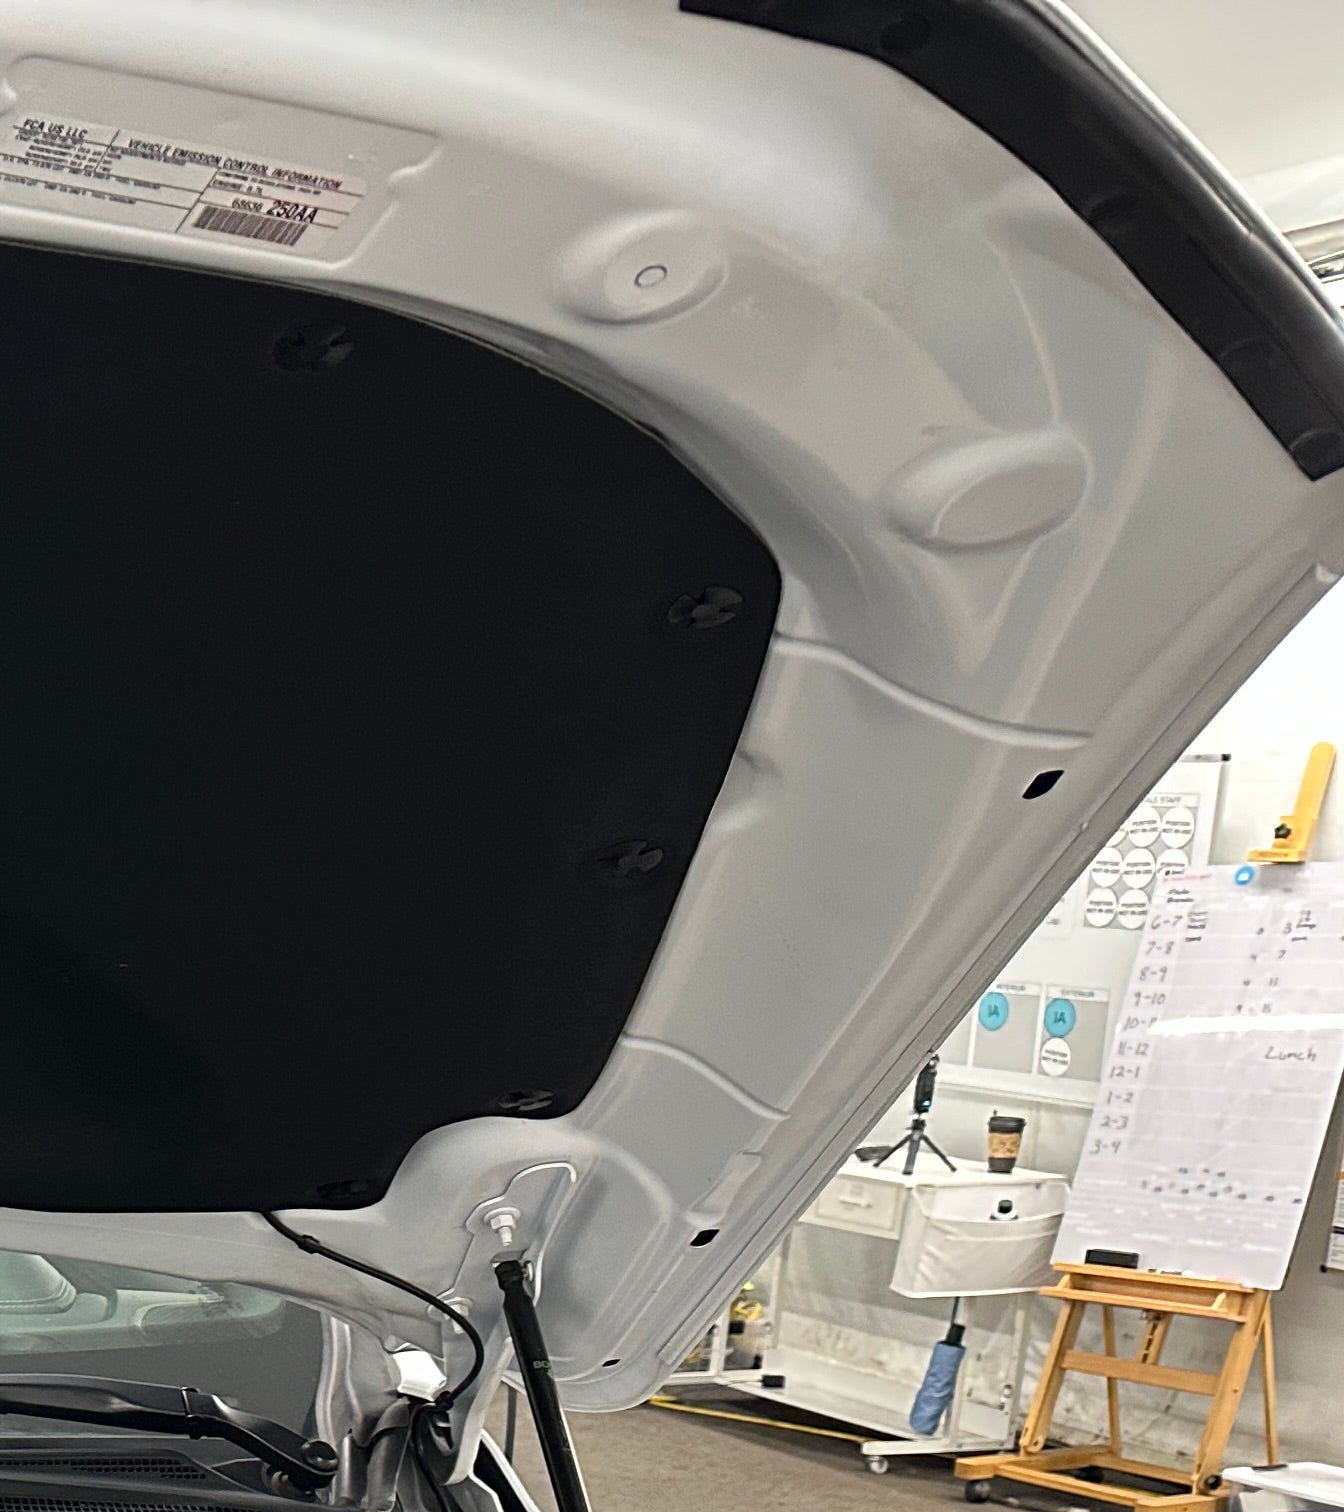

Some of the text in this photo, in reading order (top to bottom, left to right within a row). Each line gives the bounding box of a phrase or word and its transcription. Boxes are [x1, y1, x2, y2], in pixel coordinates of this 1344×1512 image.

[23, 118, 45, 131] FCA
[48, 122, 64, 134] US
[128, 137, 172, 155] VEHICLE
[173, 148, 222, 166] EMISSION
[223, 158, 269, 176] CONTROL
[272, 168, 343, 189] INFORMATION
[266, 199, 319, 223] 250AA
[1265, 1046, 1317, 1062] Lunch
